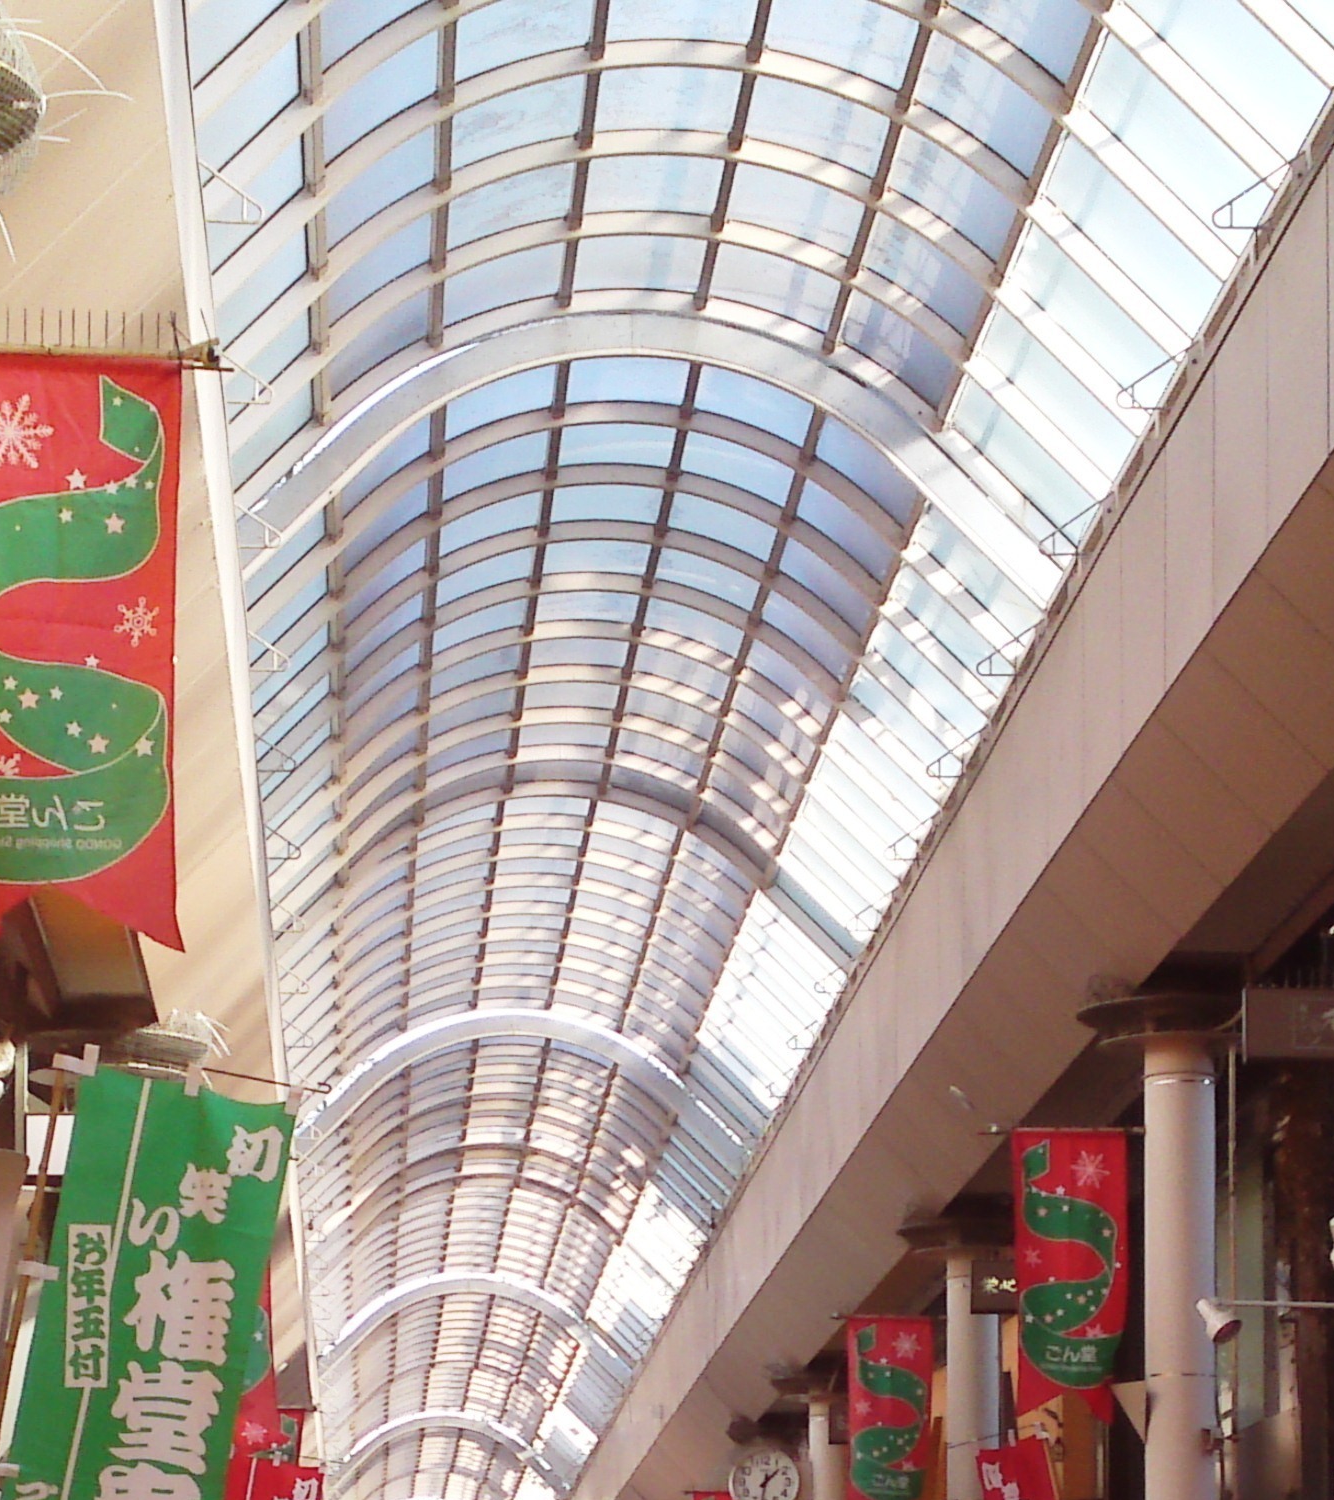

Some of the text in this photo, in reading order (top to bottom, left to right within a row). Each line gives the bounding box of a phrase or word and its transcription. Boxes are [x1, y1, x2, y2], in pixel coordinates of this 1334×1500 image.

[127, 1125, 284, 1252] 初笑い
[69, 1231, 109, 1382] お年玉付
